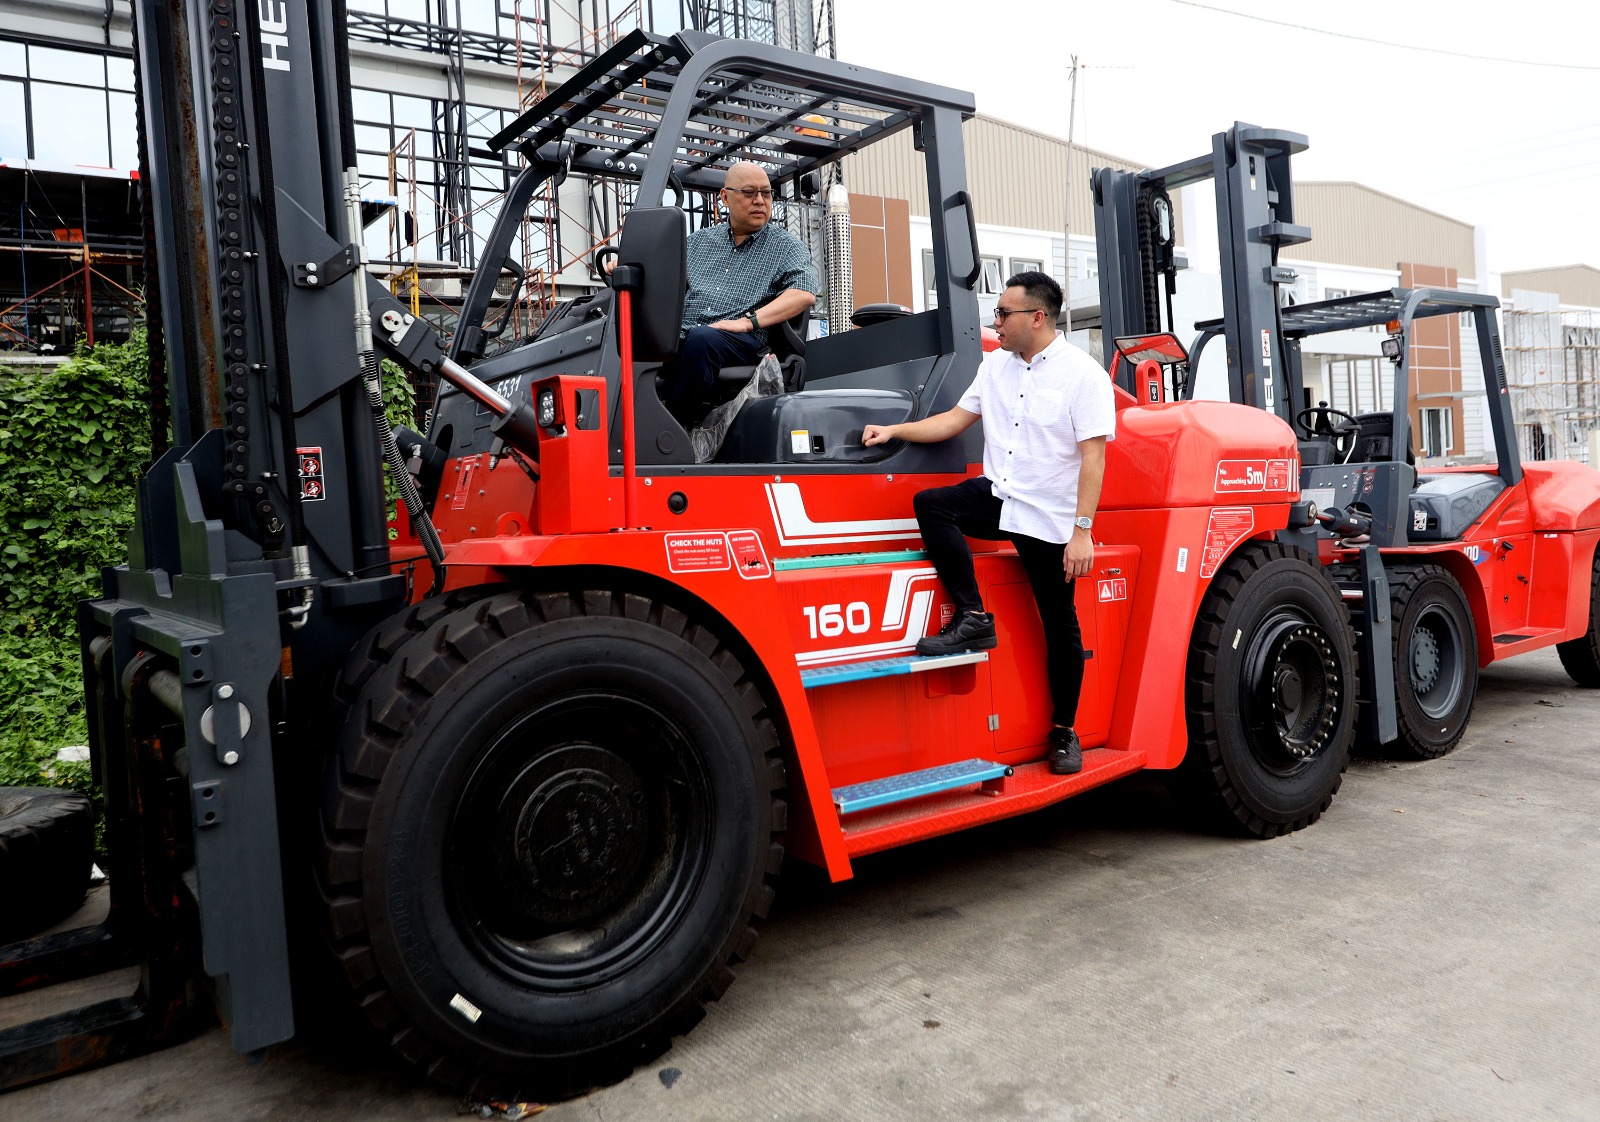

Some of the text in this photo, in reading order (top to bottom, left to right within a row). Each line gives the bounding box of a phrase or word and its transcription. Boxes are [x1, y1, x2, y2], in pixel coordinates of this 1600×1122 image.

[1220, 478, 1247, 486] Approaching
[1246, 466, 1264, 485] 5m
[670, 539, 692, 547] CHECK
[803, 601, 871, 639] 160
